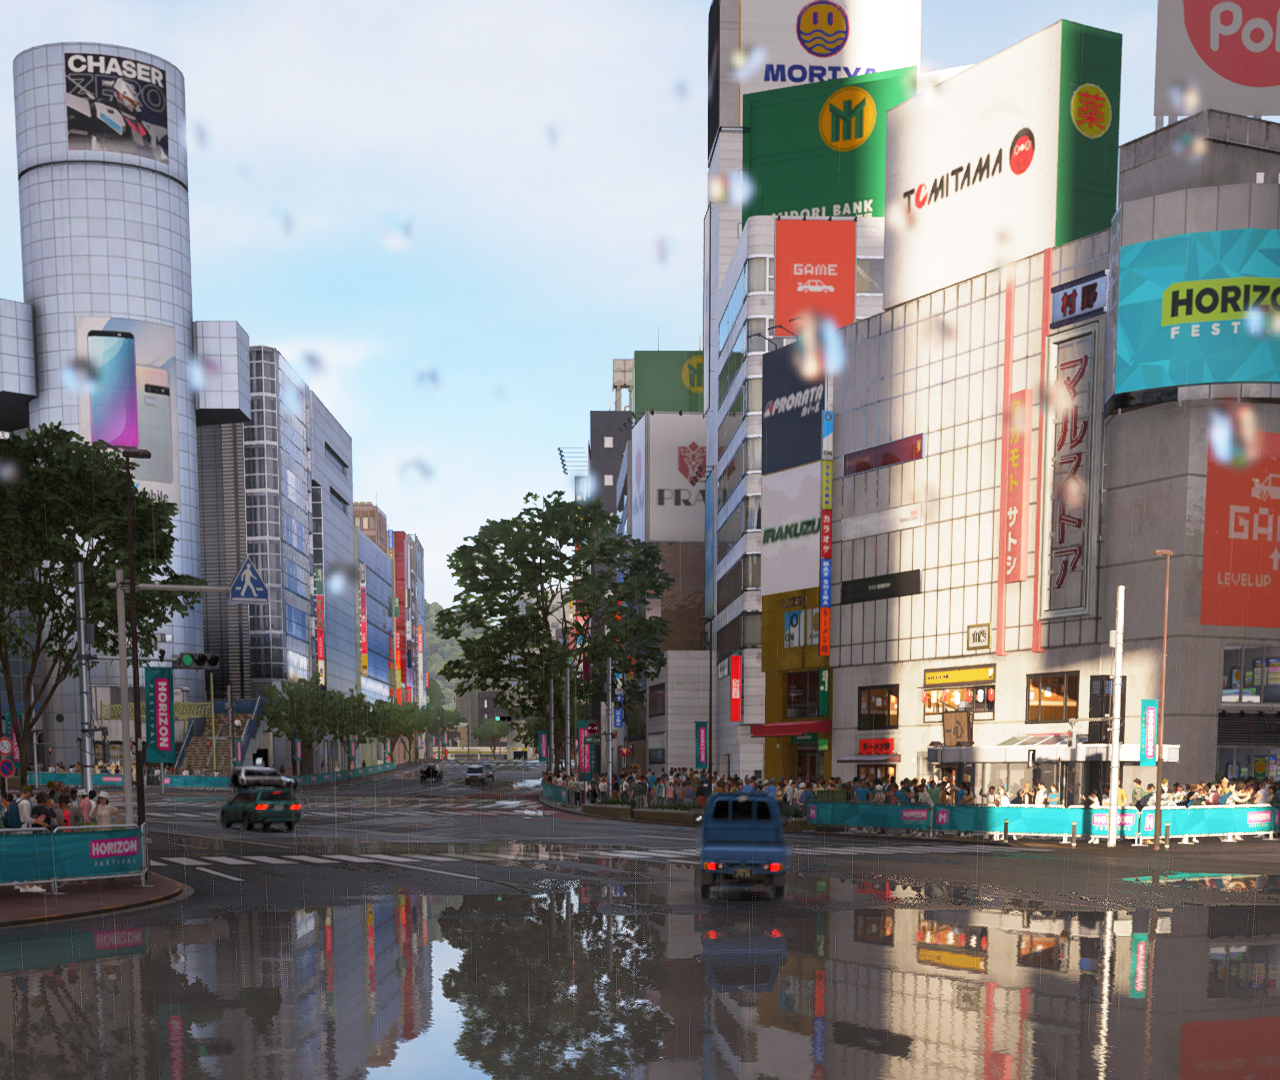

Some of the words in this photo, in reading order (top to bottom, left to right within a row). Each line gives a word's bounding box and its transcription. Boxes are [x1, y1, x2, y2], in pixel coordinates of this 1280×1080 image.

[67, 54, 165, 88] CHASER
[1076, 90, 1106, 132] 薬
[902, 147, 1003, 215] TOMITAMA
[832, 199, 875, 217] BANK
[793, 263, 838, 276] GAME
[1006, 506, 1019, 575] サトシ
[157, 680, 169, 748] HORIZON
[938, 811, 947, 823] H
[91, 837, 138, 857] HORIZON
